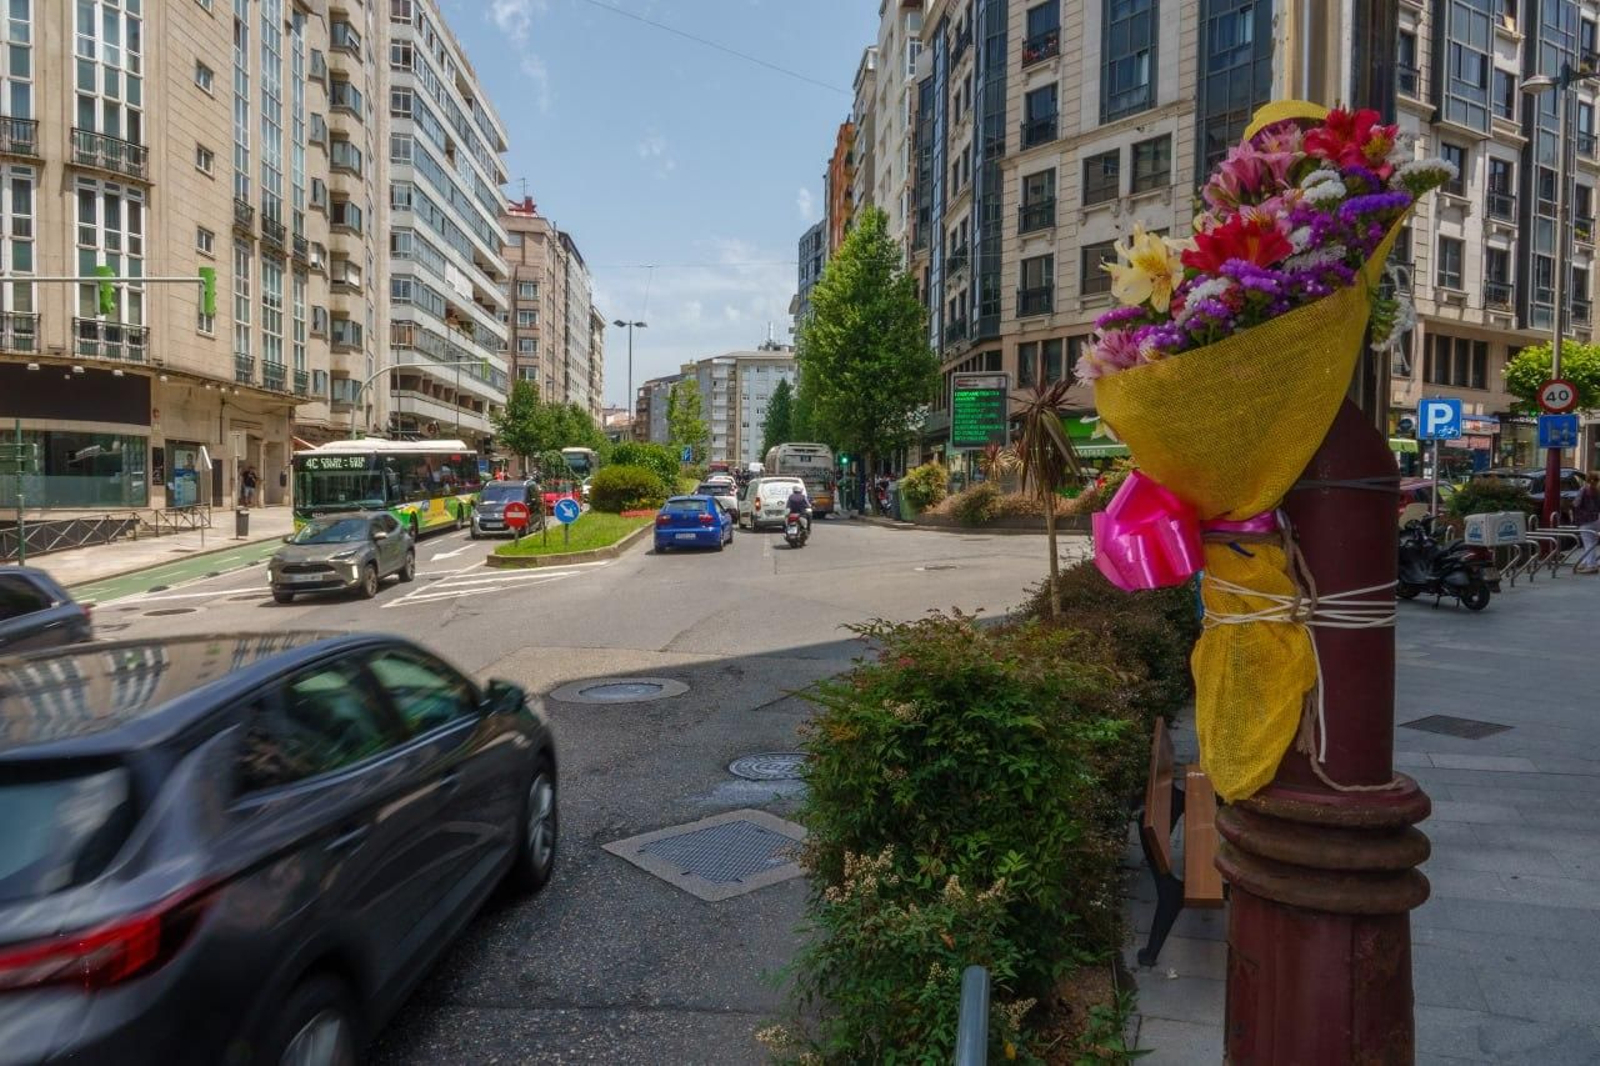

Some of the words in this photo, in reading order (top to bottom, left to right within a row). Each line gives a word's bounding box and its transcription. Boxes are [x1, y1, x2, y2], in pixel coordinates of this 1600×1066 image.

[1545, 390, 1570, 402] 40
[1427, 402, 1454, 435] P
[305, 457, 319, 470] 4C
